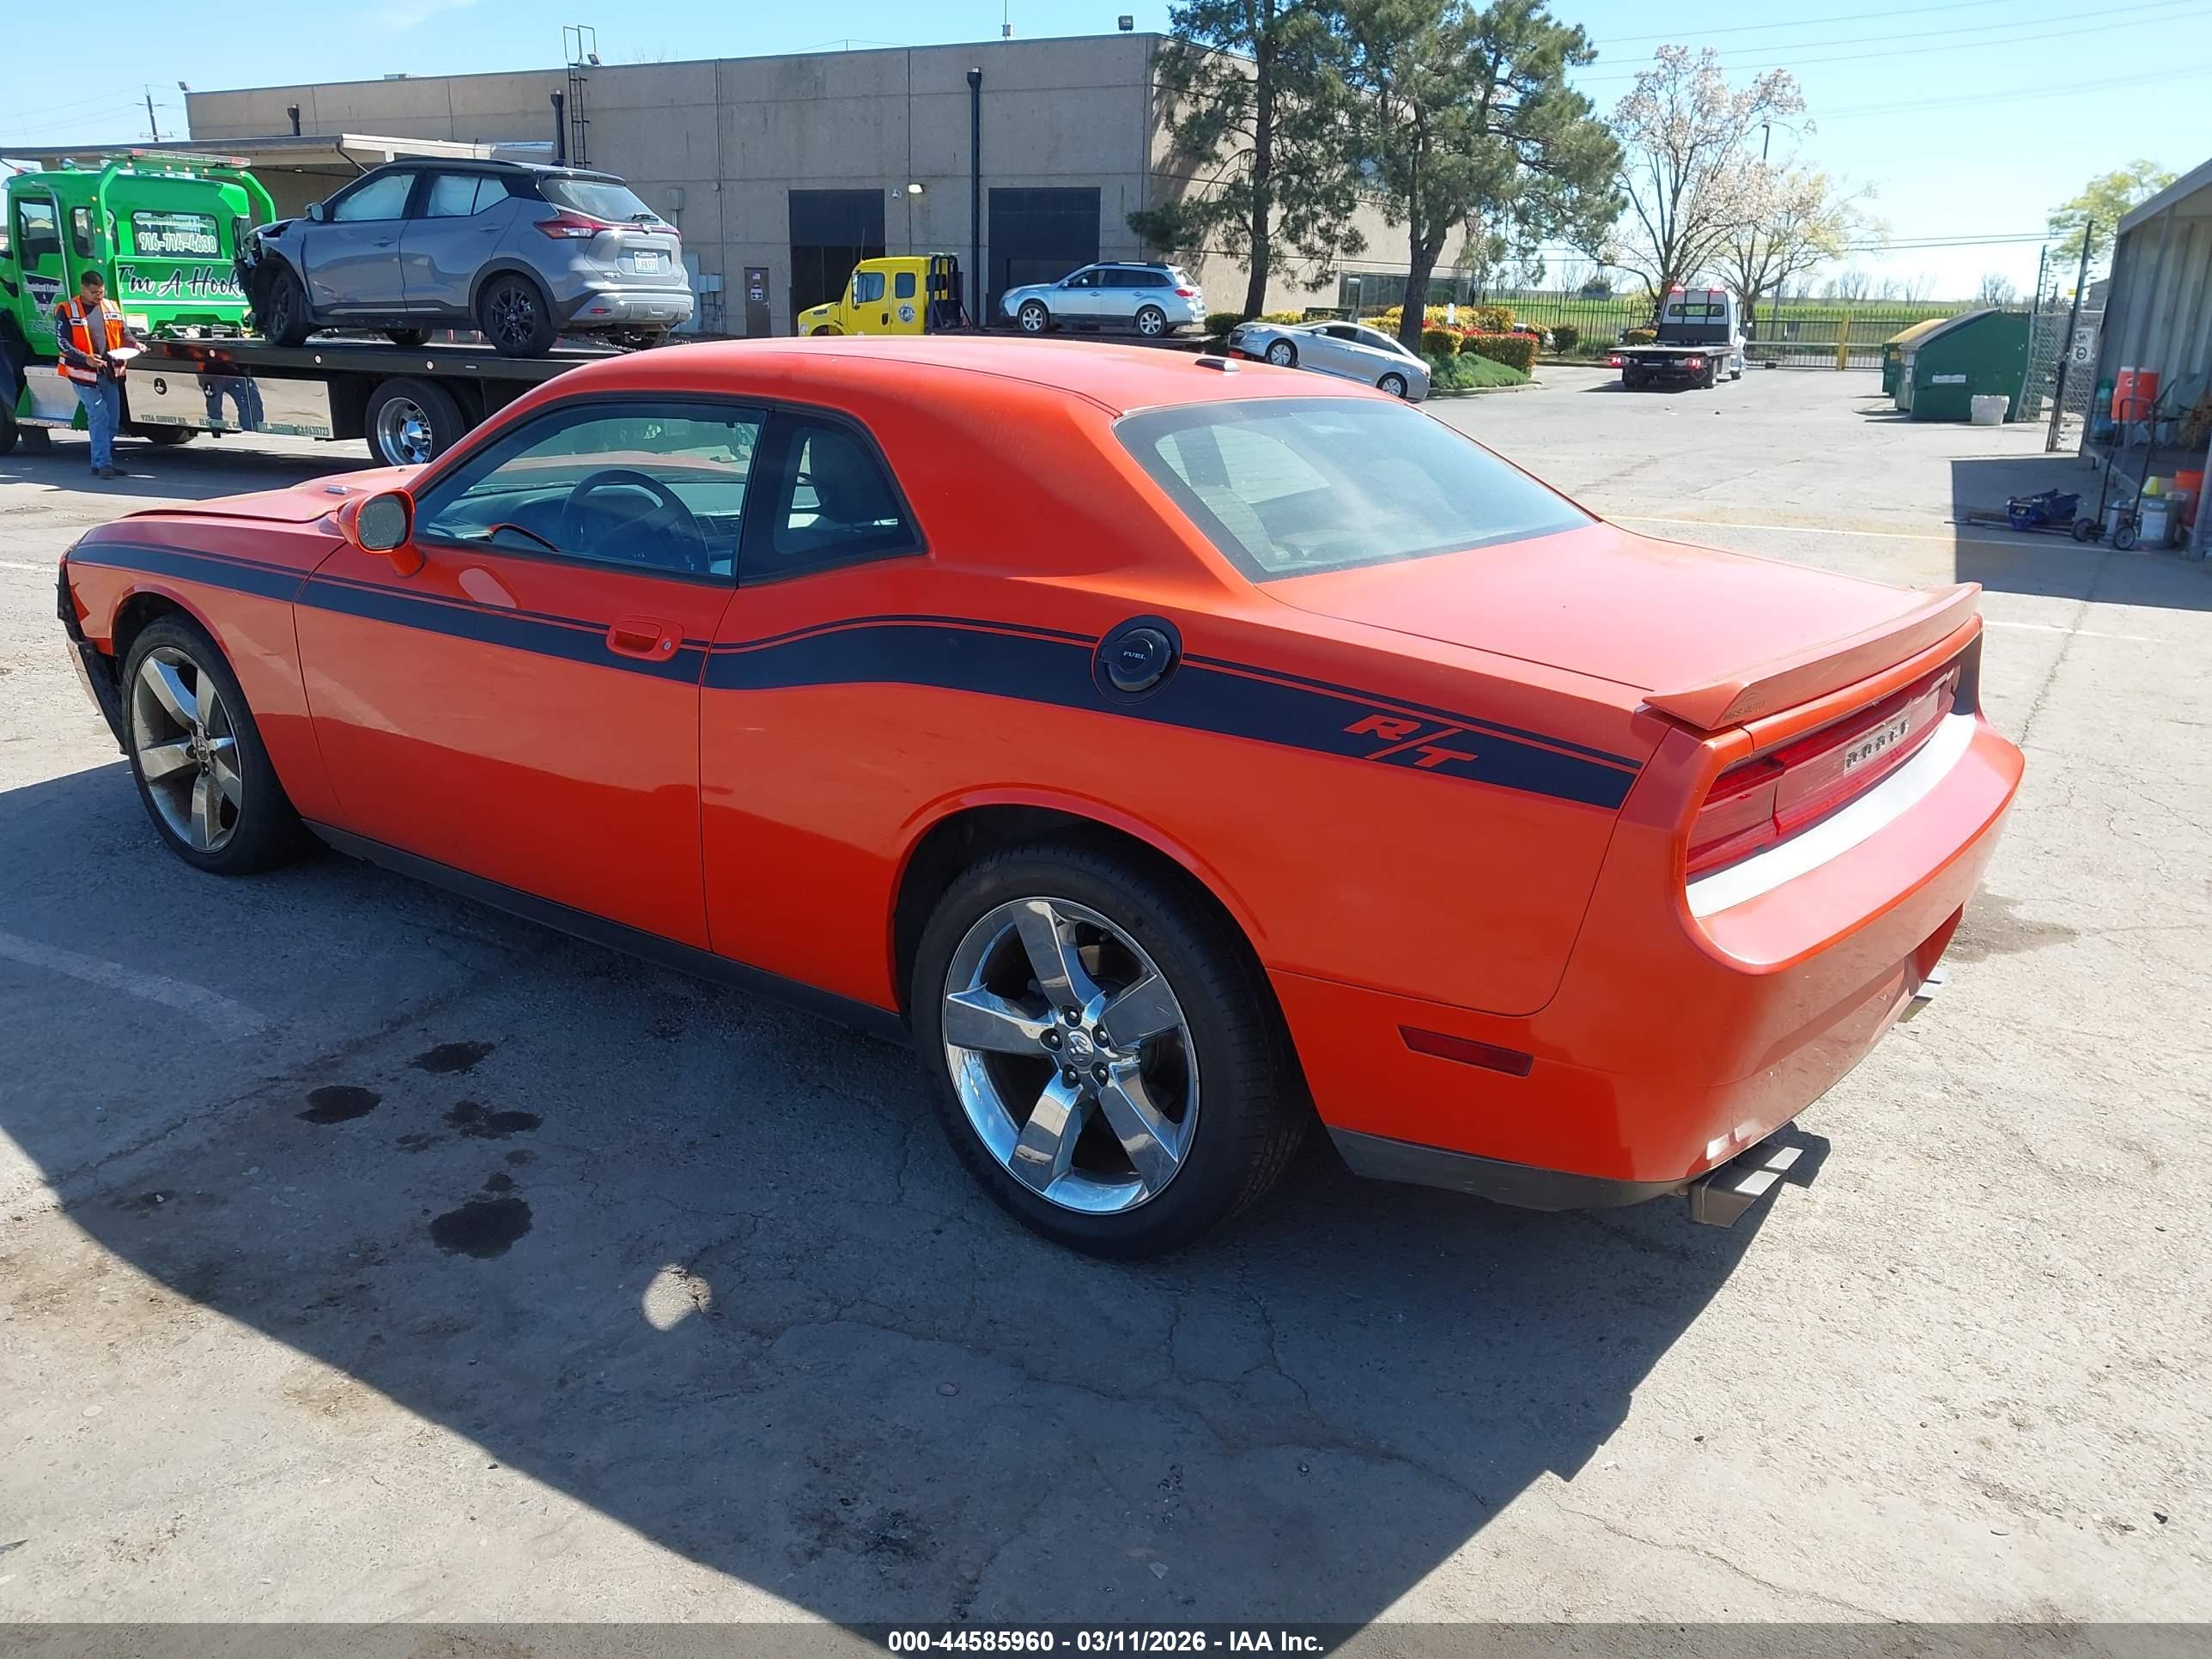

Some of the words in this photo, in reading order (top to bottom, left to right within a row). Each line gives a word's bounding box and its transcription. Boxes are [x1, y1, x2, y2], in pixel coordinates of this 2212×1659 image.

[139, 232, 217, 253] 916-714-4638
[156, 268, 182, 297] A
[186, 265, 246, 299] Hook
[1123, 650, 1146, 660] FUEL
[1343, 714, 1479, 769] R/T
